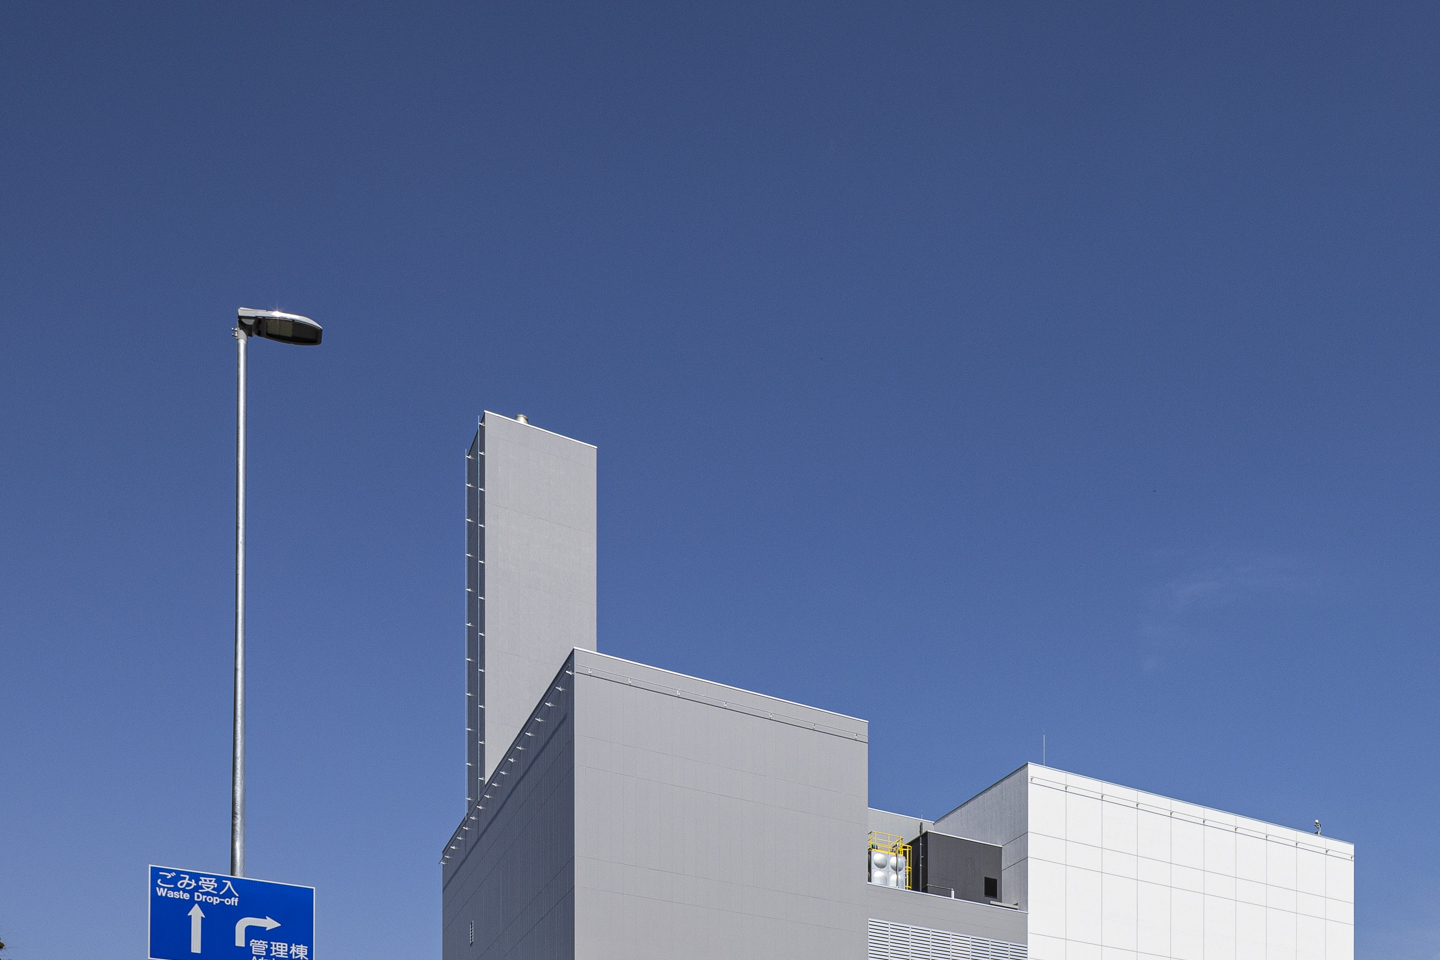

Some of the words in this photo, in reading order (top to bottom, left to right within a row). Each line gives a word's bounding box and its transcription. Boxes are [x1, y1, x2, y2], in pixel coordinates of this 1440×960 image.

[156, 871, 239, 897] ごみ受入
[156, 887, 190, 900] Waste
[194, 892, 239, 907] Drop-off
[249, 939, 309, 960] 管理棟
